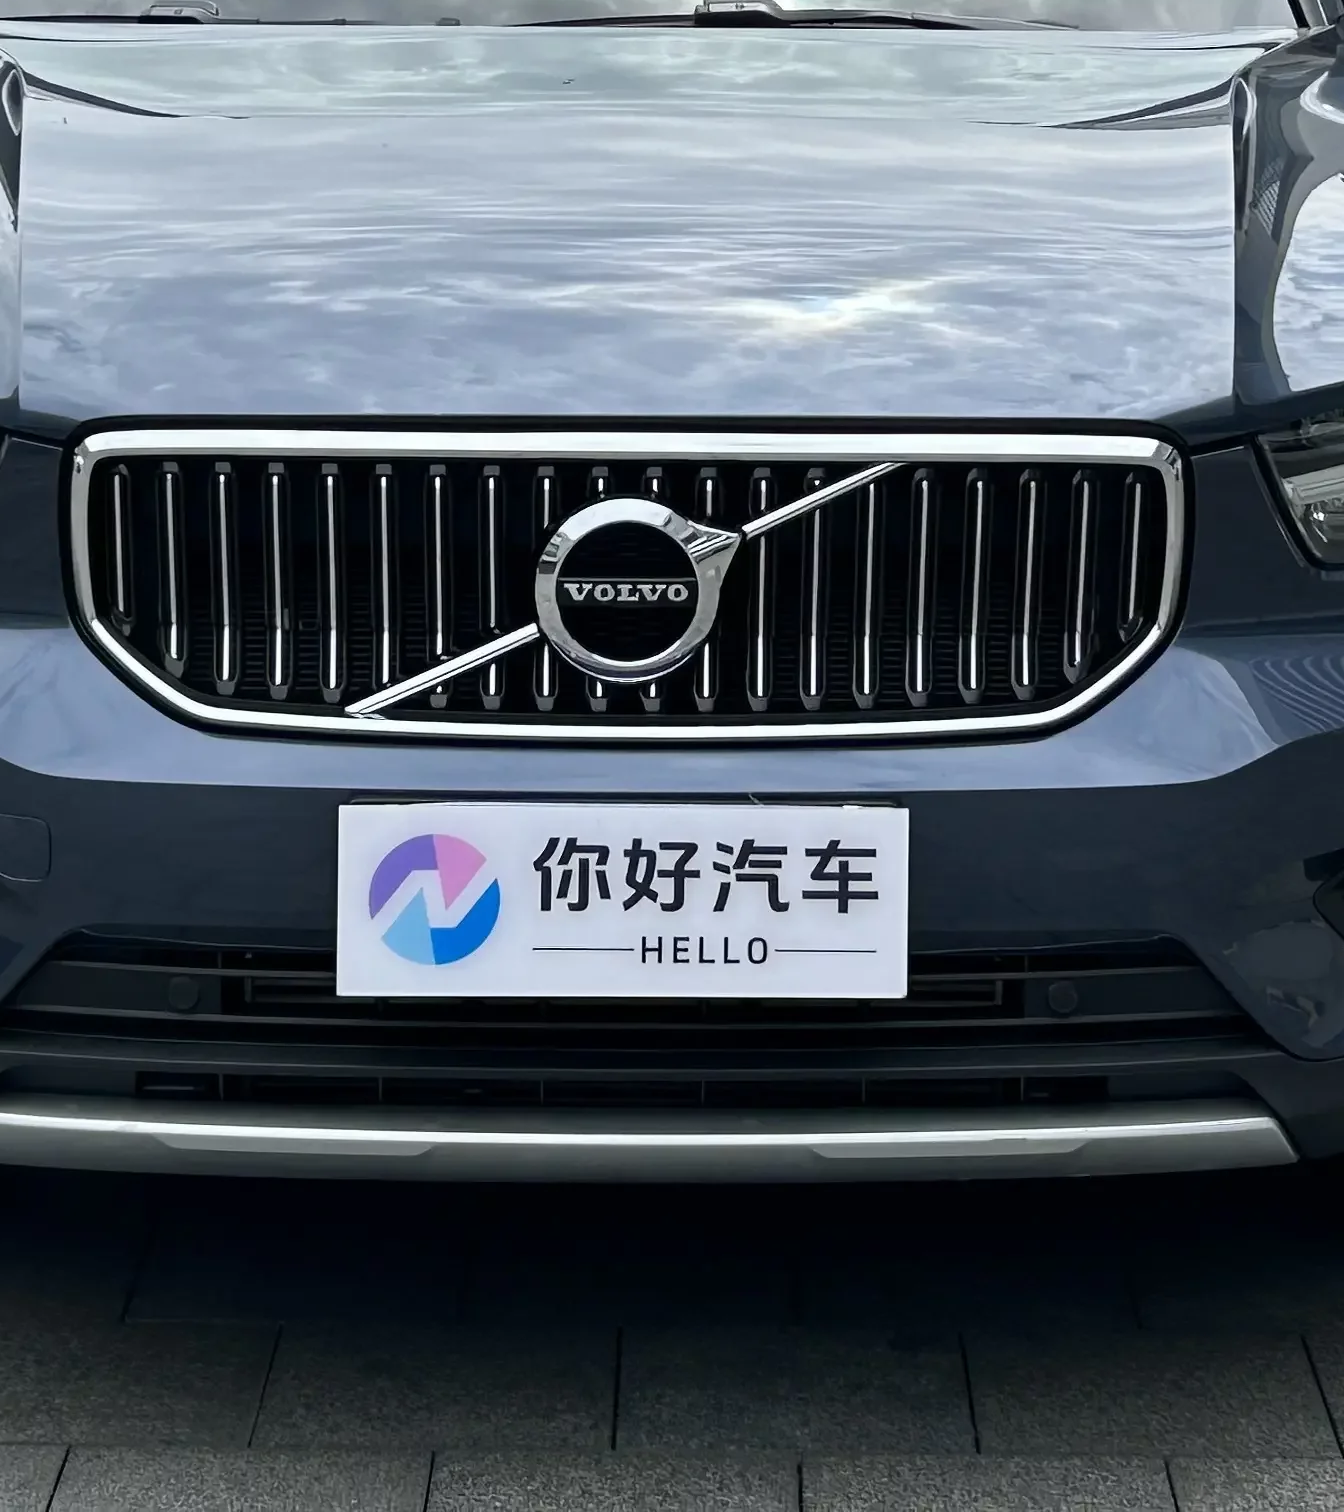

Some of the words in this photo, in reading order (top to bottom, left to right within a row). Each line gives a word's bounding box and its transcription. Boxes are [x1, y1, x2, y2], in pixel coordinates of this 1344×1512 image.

[563, 583, 689, 602] VOLVO
[532, 837, 879, 914] 你好汽车
[640, 936, 770, 965] HELLO
